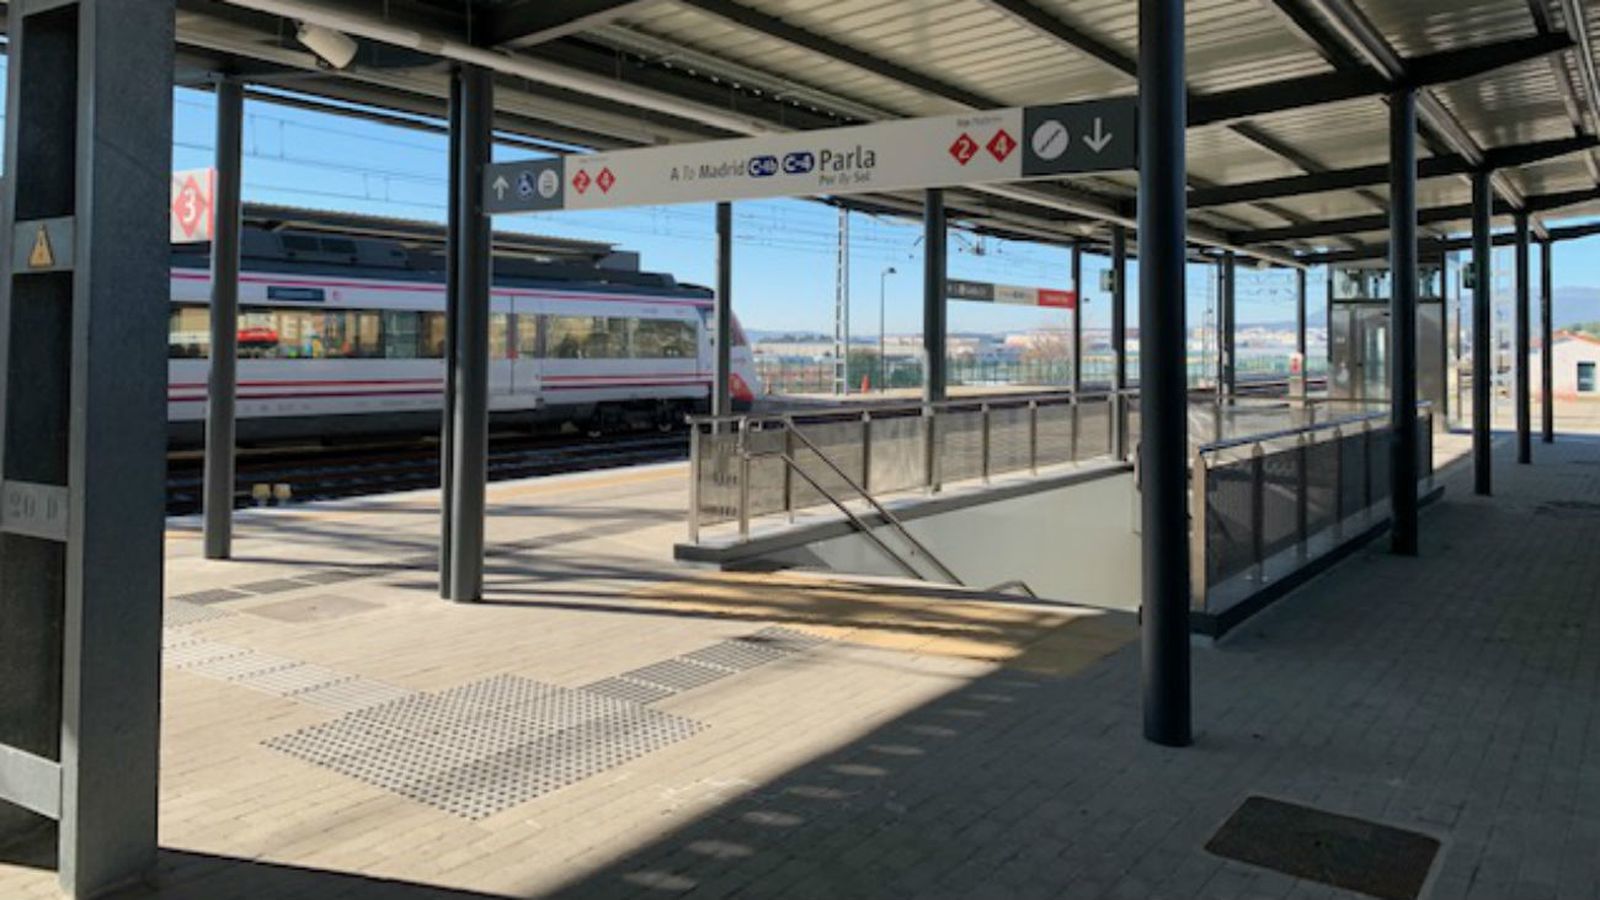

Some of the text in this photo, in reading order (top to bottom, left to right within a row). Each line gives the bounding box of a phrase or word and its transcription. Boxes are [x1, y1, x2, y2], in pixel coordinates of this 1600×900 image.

[959, 135, 1007, 159] 2 4
[670, 167, 679, 180] A
[699, 159, 744, 178] Madrid
[784, 154, 812, 173] C-4
[819, 145, 876, 172] Parla
[576, 172, 611, 190] 2 4
[184, 187, 196, 222] 3
